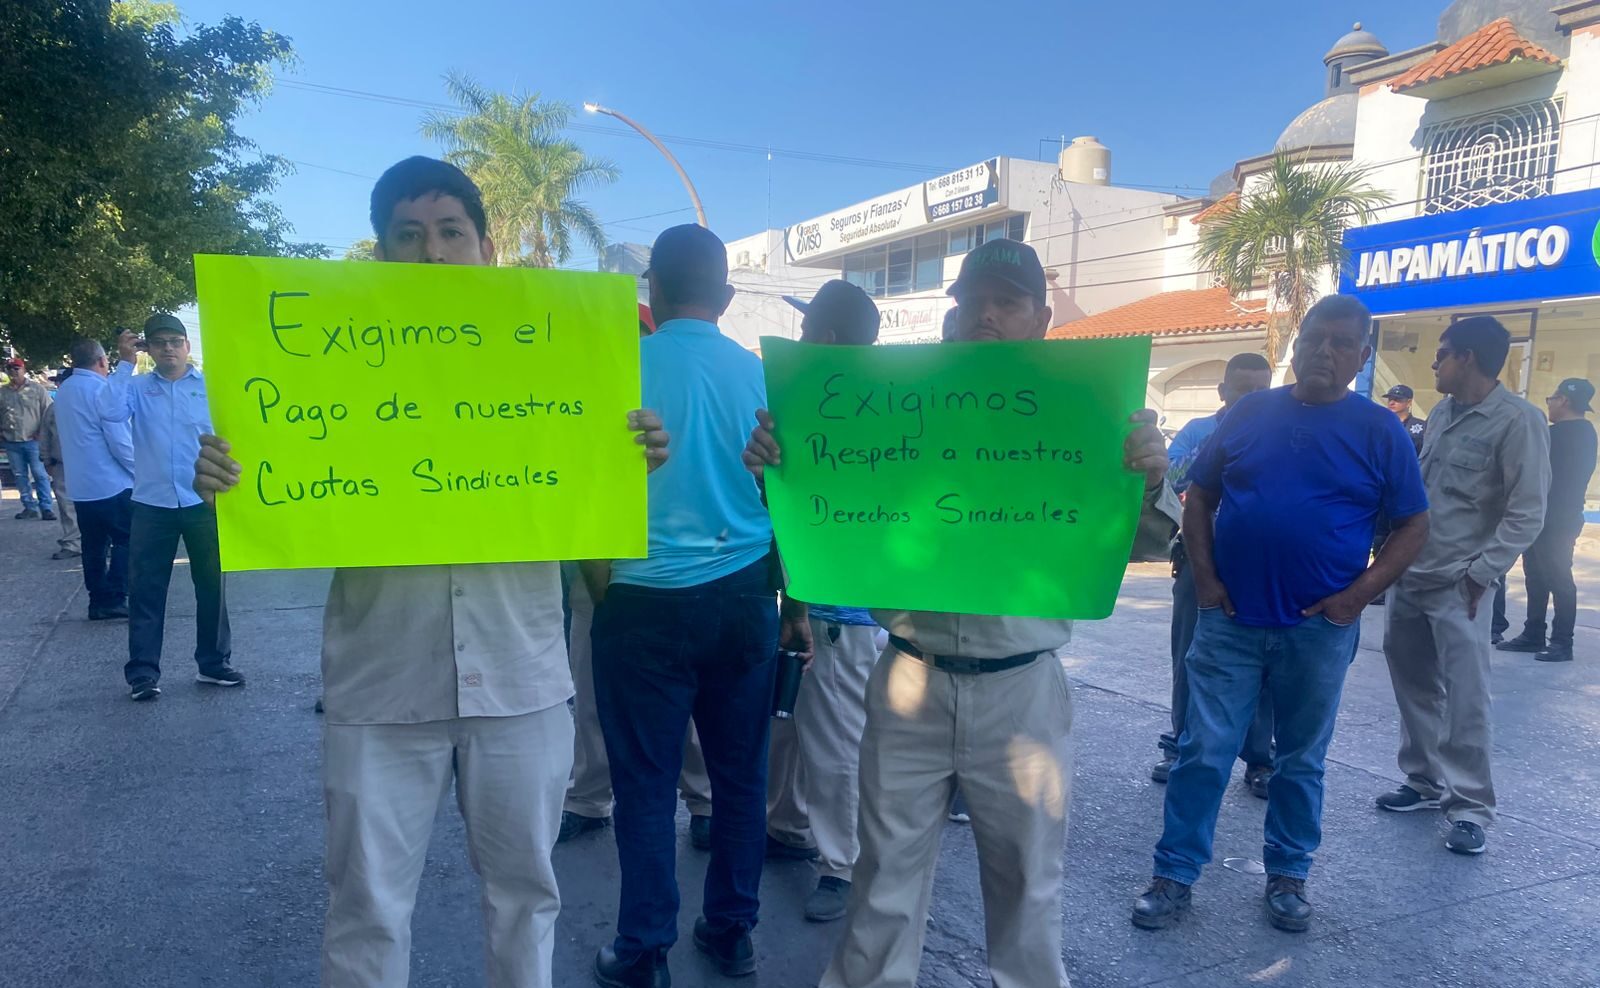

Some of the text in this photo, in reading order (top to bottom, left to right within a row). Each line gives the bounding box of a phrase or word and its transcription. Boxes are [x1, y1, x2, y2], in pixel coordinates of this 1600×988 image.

[938, 175, 950, 188] 668
[952, 171, 964, 185] 815
[965, 168, 973, 180] 31
[976, 165, 984, 177] 13
[830, 199, 903, 232] Seguros y Fianzas
[937, 193, 983, 216] 668 157 02 38
[803, 223, 820, 237] GRUPO
[839, 218, 897, 243] Seguridad Absoluta
[1356, 227, 1570, 287] JAPAMÁTICO
[268, 290, 552, 368] Exigimos el
[900, 306, 933, 331] Digital
[244, 377, 584, 440] Pago de nuestras
[818, 373, 1039, 438] Exigimos
[805, 432, 1084, 472] Respeto a nuestros
[257, 458, 559, 506] Cuotas Sindicales
[809, 492, 1079, 527] Derechos Sindicales
